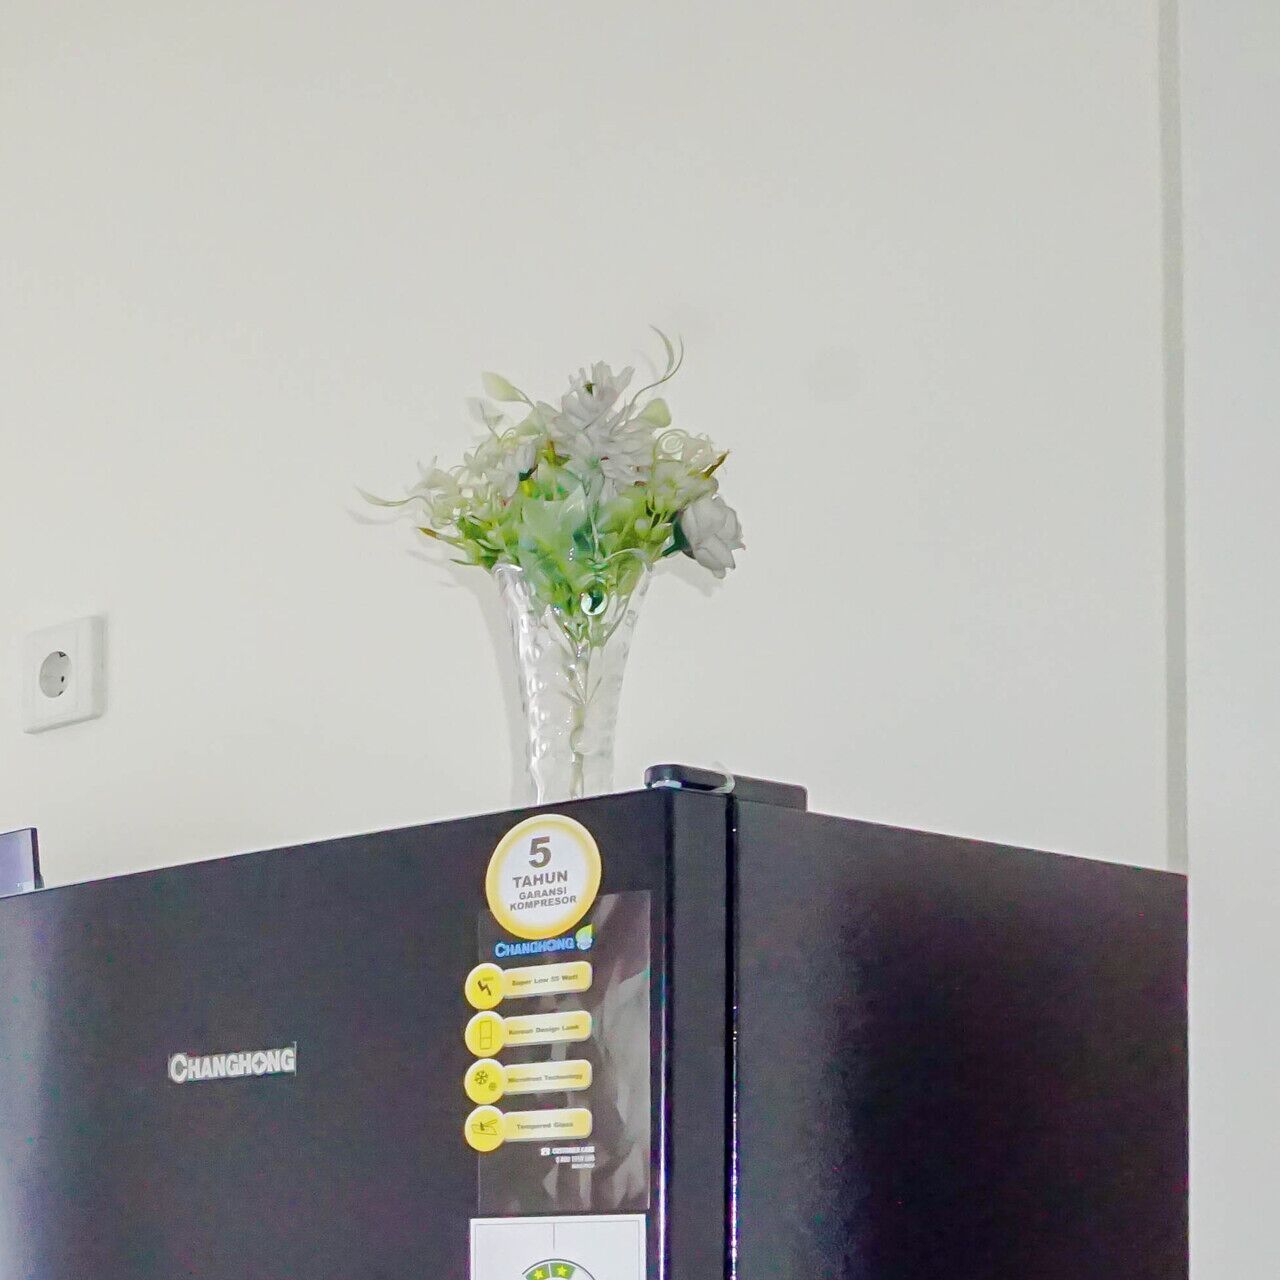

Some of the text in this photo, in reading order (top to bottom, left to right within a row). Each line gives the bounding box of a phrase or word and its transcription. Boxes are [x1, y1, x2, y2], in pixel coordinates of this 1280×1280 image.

[528, 836, 552, 868] 5
[512, 870, 568, 888] TAHUN
[510, 895, 577, 911] KOMPRESOR
[519, 887, 567, 900] GARANSI
[495, 937, 575, 957] CHANGHONG
[170, 1047, 296, 1084] CHANGHONG
